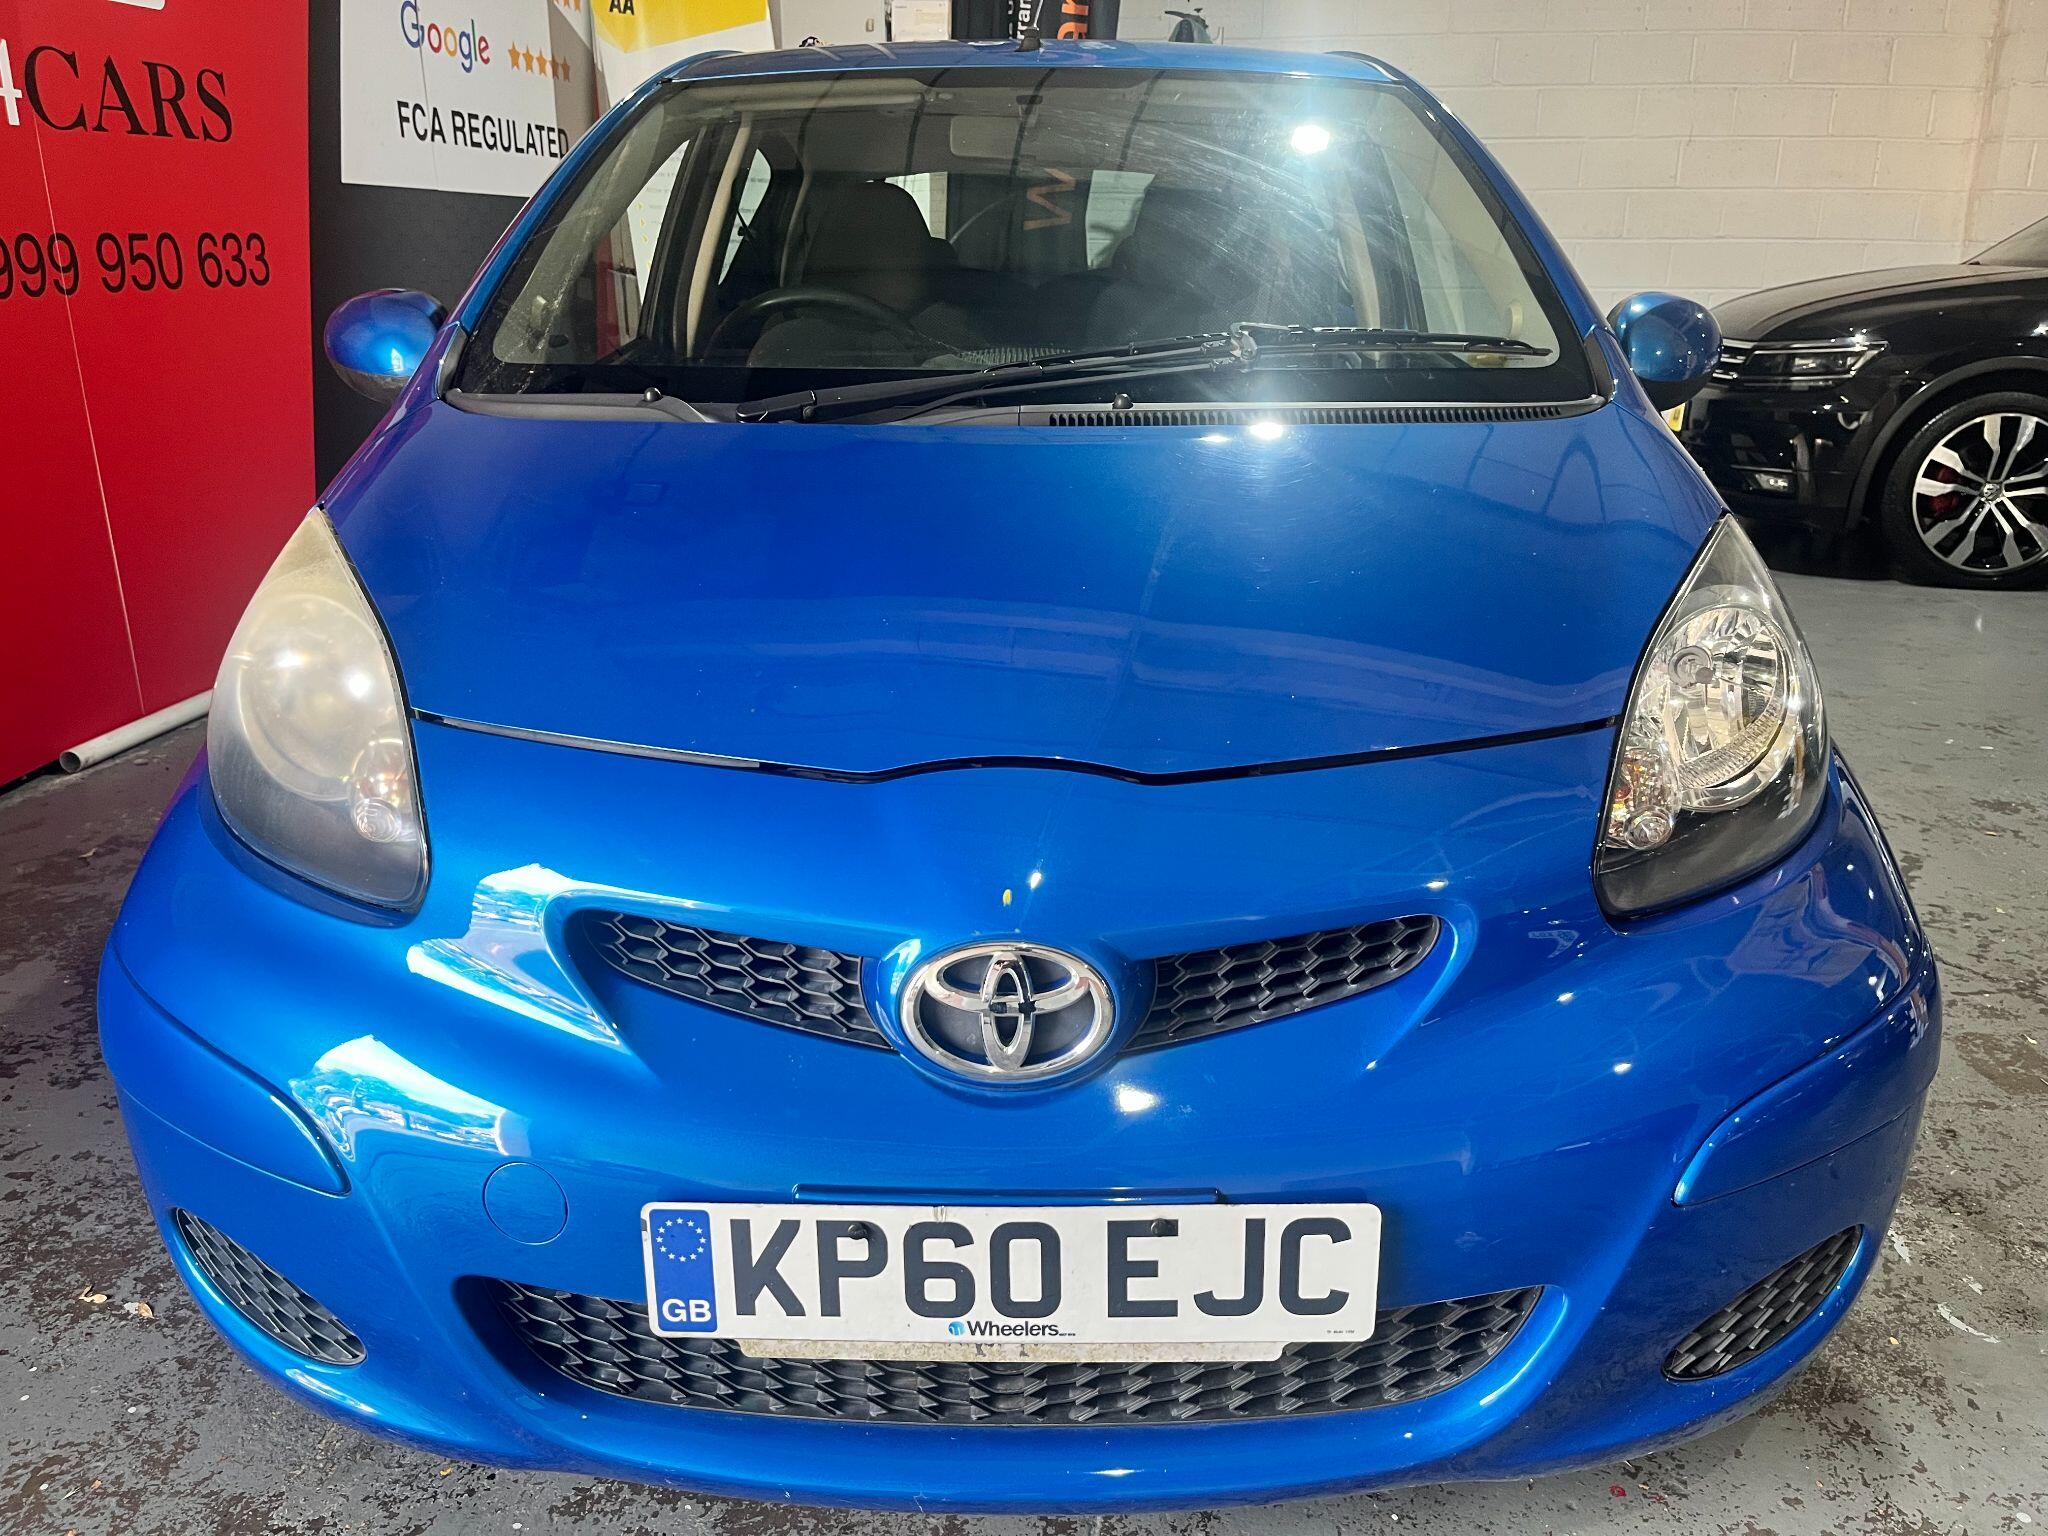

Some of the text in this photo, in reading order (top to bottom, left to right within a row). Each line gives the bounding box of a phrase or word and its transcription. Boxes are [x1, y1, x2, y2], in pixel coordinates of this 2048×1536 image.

[401, 0, 490, 73] Google
[397, 101, 569, 159] FCA REGULATED
[96, 232, 183, 293] 950
[197, 232, 270, 288] 633
[730, 1218, 1351, 1318] KP60 EJC
[661, 1299, 712, 1323] GB
[967, 1321, 1059, 1336] Wheelers
